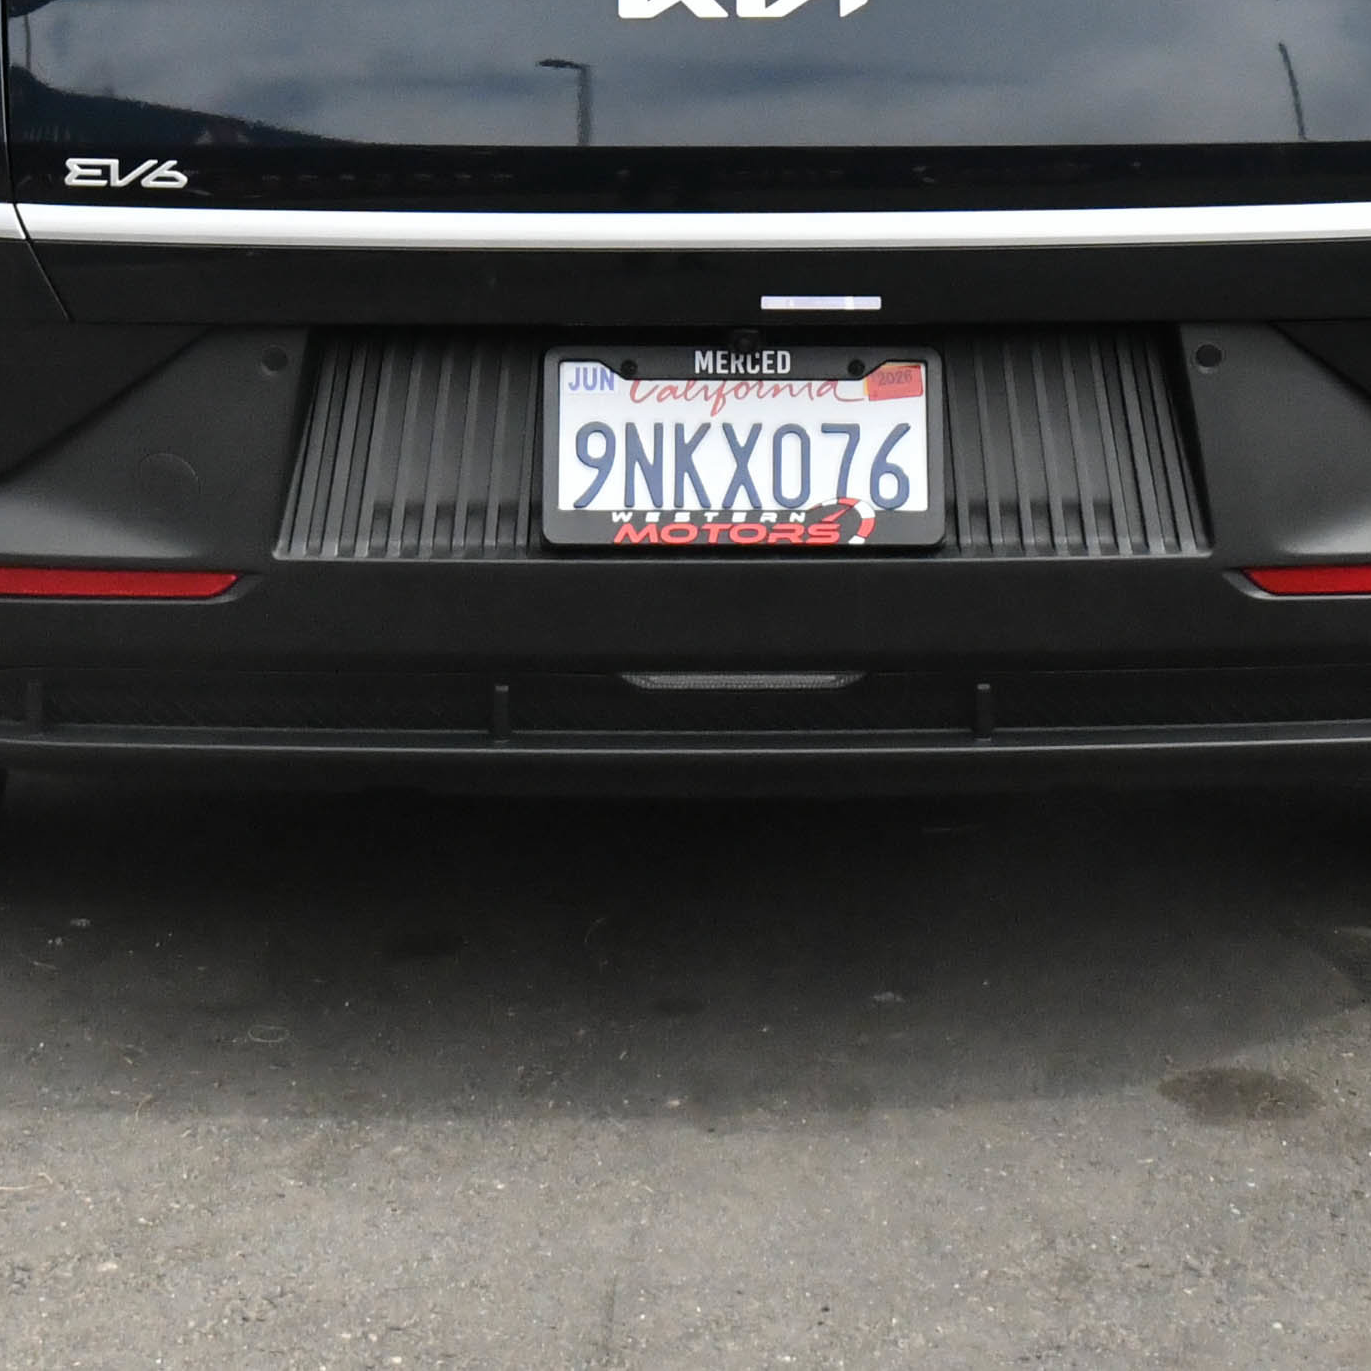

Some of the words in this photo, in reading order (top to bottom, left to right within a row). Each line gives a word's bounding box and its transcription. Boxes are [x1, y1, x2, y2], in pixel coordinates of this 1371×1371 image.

[64, 157, 188, 190] EV6
[694, 350, 791, 375] MERCED
[568, 366, 615, 391] JUN
[629, 379, 865, 417] California
[573, 421, 911, 510] 9NKX076
[611, 511, 806, 524] WESTERN
[613, 522, 842, 545] MOTORS
